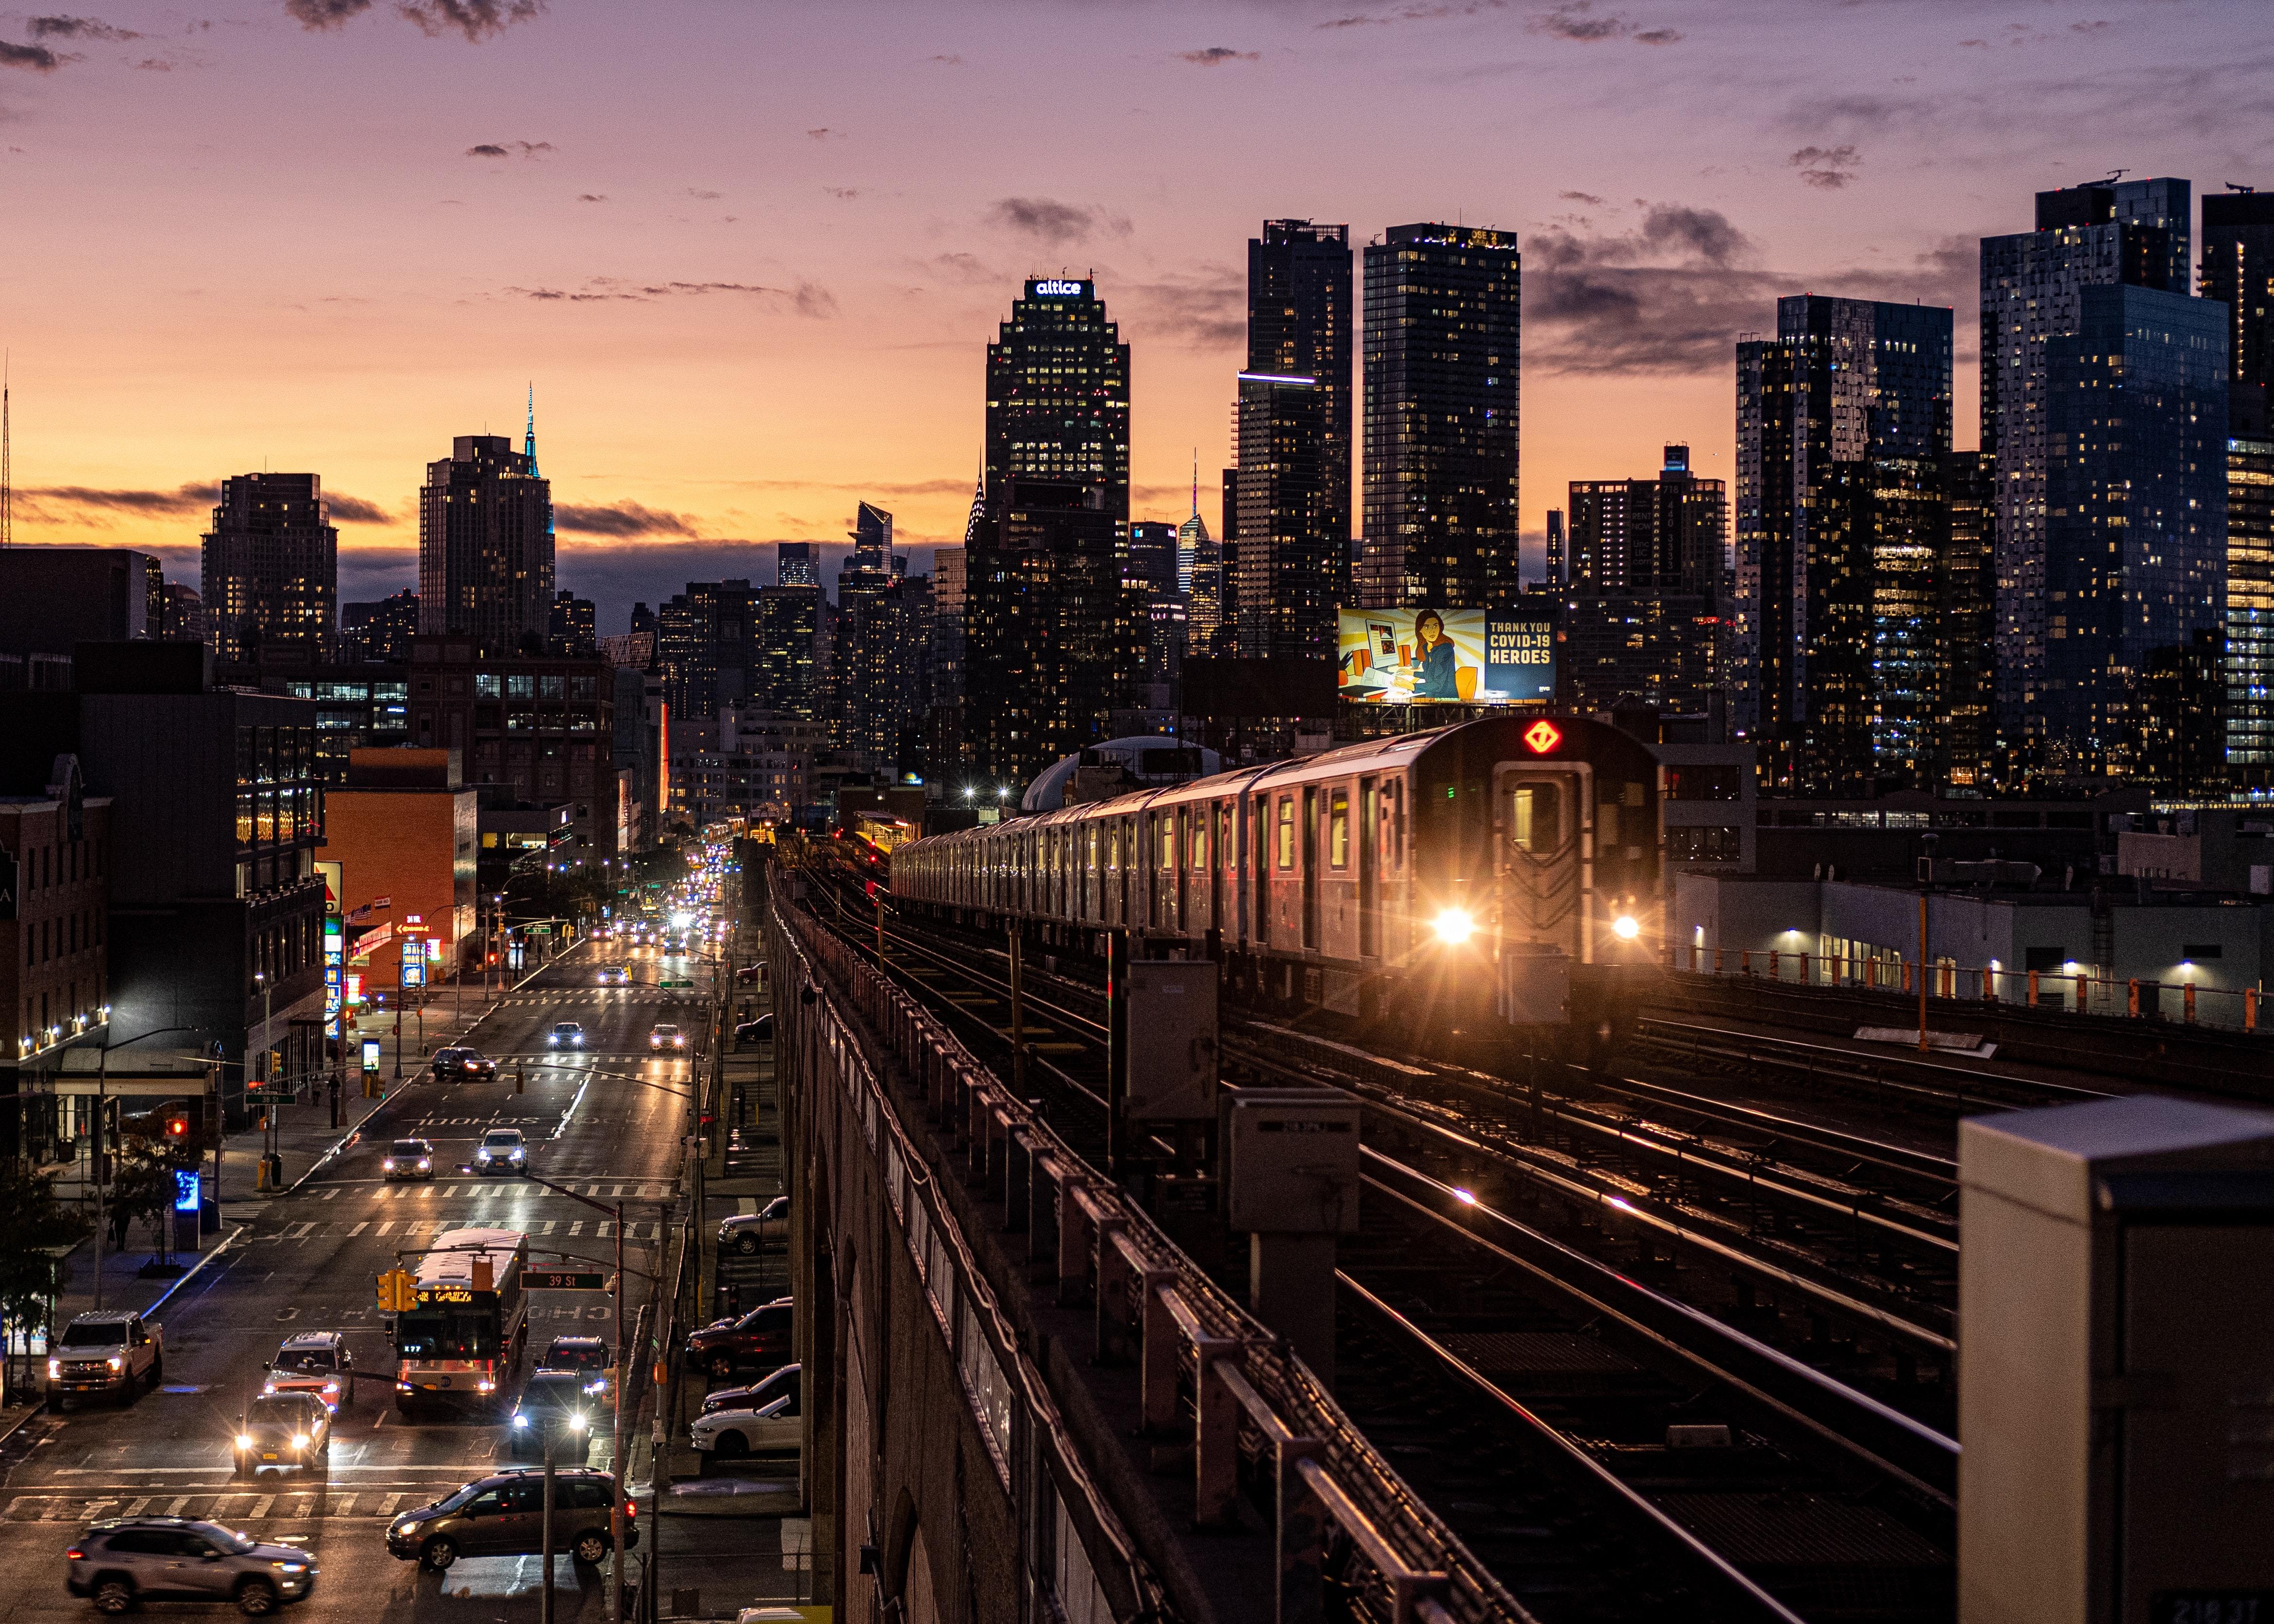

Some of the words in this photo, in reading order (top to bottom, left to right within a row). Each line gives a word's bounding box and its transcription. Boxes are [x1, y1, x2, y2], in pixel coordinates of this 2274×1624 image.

[1036, 280, 1081, 294] altice
[1664, 485, 1679, 494] 718
[1490, 622, 1527, 633] THANK
[1530, 622, 1550, 633] YOU
[1490, 635, 1550, 647] COVID-19
[1490, 649, 1550, 664] HEROES
[549, 1275, 561, 1287] 39
[566, 1275, 575, 1287] St
